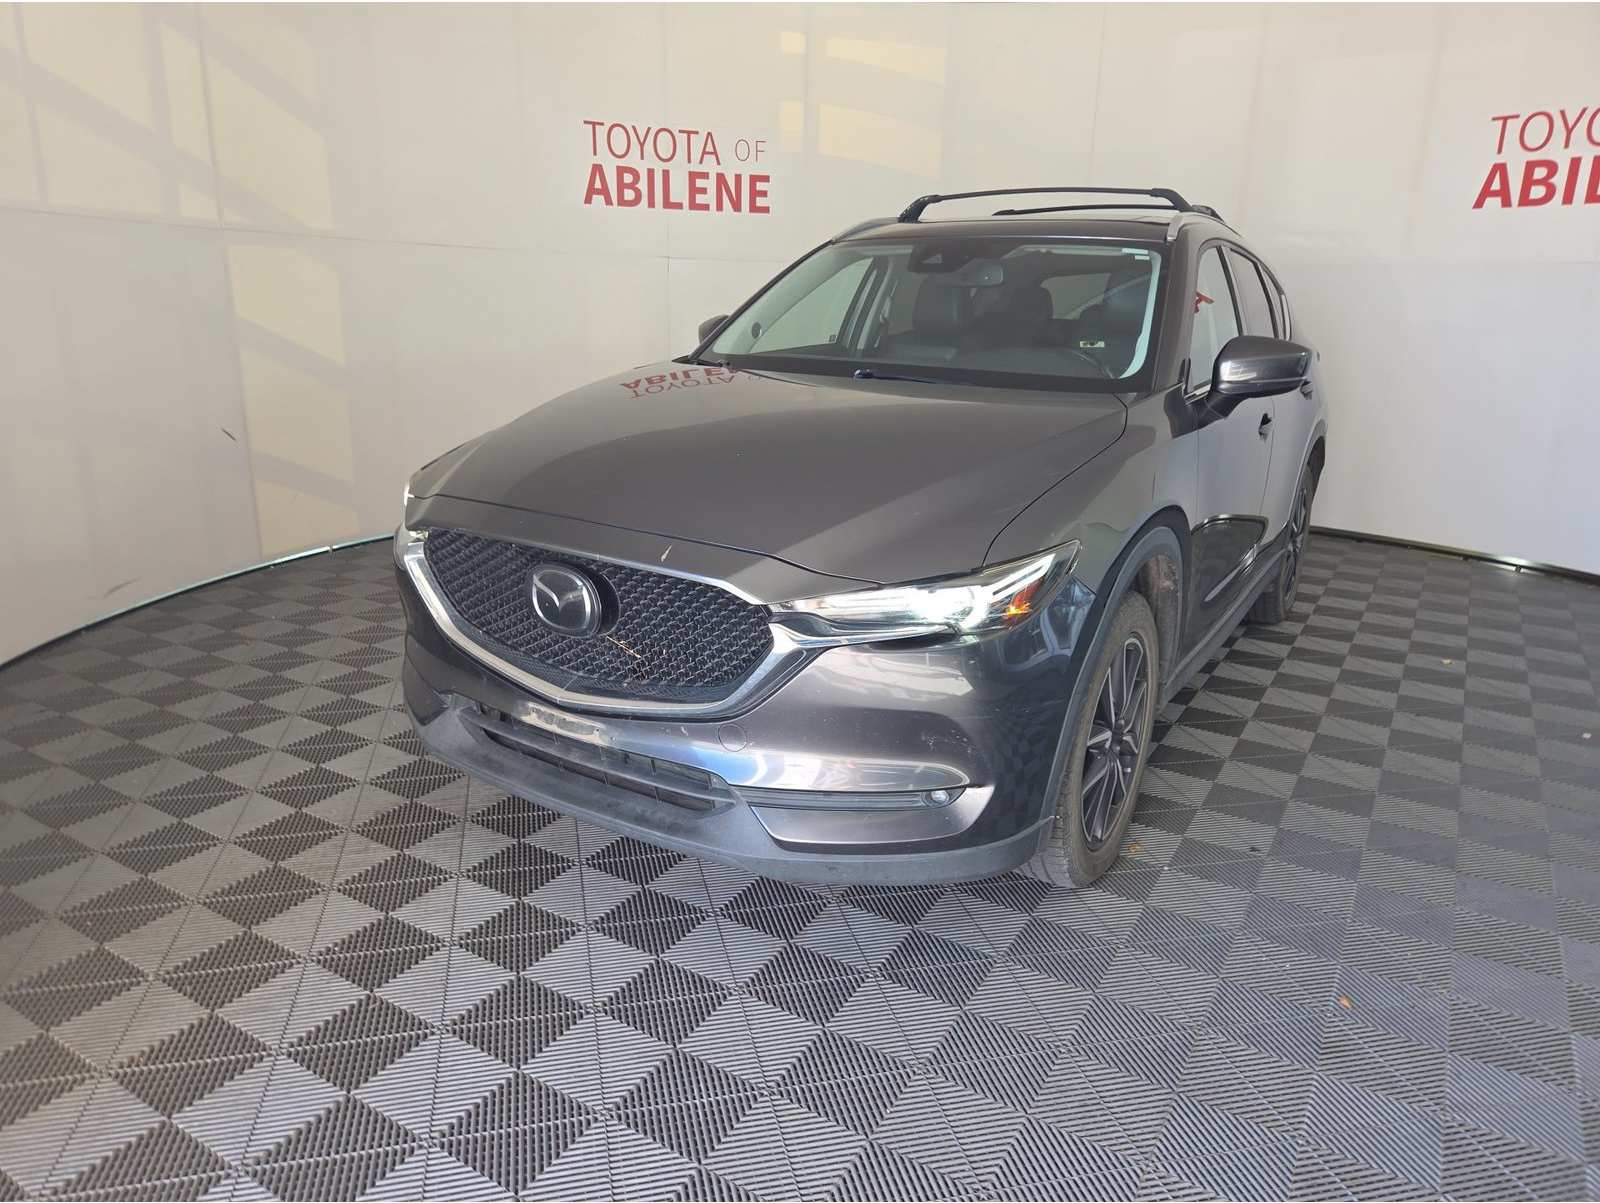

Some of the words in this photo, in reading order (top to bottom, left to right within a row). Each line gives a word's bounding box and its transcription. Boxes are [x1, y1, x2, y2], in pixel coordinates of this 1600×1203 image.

[583, 120, 721, 166] TOYOTA
[735, 138, 767, 162] OF
[583, 163, 770, 214] ABILENE
